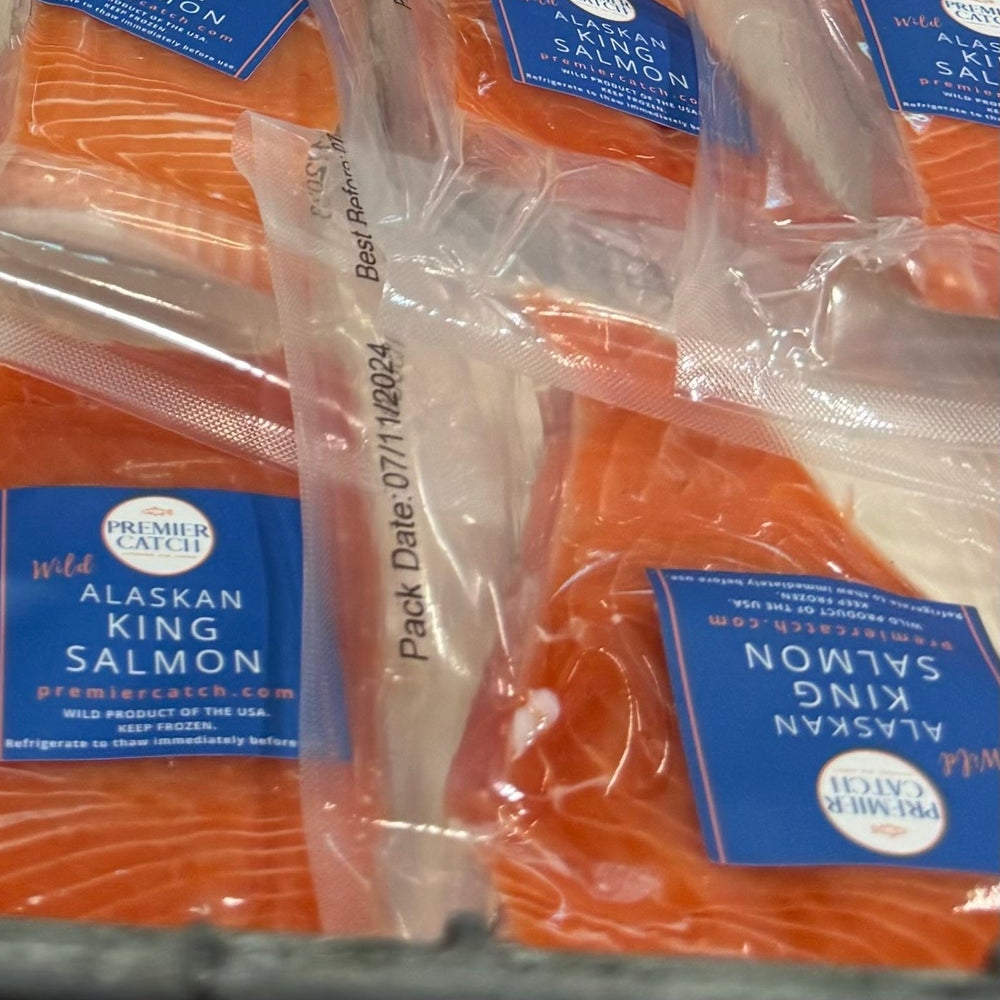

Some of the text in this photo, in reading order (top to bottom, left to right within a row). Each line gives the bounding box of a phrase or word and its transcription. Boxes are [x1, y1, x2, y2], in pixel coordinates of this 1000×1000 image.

[104, 3, 127, 15] KEEP
[894, 15, 941, 29] Wild
[95, 6, 119, 21] thaw
[121, 17, 181, 47] immediately
[183, 44, 215, 62] before
[217, 58, 237, 72] use.
[151, 13, 164, 23] OF
[167, 21, 184, 33] THE
[187, 30, 207, 44] USA.
[555, 11, 667, 51] ALASKAN
[577, 29, 654, 63] KING
[938, 32, 1000, 53] ALAS
[555, 38, 689, 89] SALMON
[936, 61, 1000, 85] SAL
[526, 73, 583, 93] Refrigerate
[586, 88, 596, 96] to
[600, 93, 624, 105] thaw
[626, 102, 687, 131] immediately
[561, 68, 674, 109] WILD PRODUCT OF THE
[600, 86, 624, 100] KEEP
[352, 231, 379, 282] Best
[367, 343, 428, 661] Pack Date: 07/11/2024
[107, 520, 209, 537] PREMIER
[116, 535, 200, 552] CATCH
[32, 553, 93, 580] Wild
[80, 584, 242, 609] ALASKAN
[698, 576, 963, 620] Refrigerate to thaw immediately before
[776, 592, 869, 609] KEEP FROZEN.
[108, 613, 218, 641] KING
[766, 603, 923, 630] WILD PRODUCT OF THE
[709, 615, 954, 650] premiercatch.com
[65, 645, 262, 675] SALMON
[744, 643, 940, 681] SALMON
[37, 685, 294, 699] premiercatch.com
[794, 681, 909, 711] KING
[63, 707, 270, 719] WILD PRODUCT OF THE USA.
[118, 721, 217, 732] KEEP FROZEN.
[774, 715, 942, 742] ALASKAN
[5, 736, 297, 751] Refrigerate to thaw immediately before
[831, 776, 923, 798] CATCH
[825, 796, 940, 820] PREMIER
